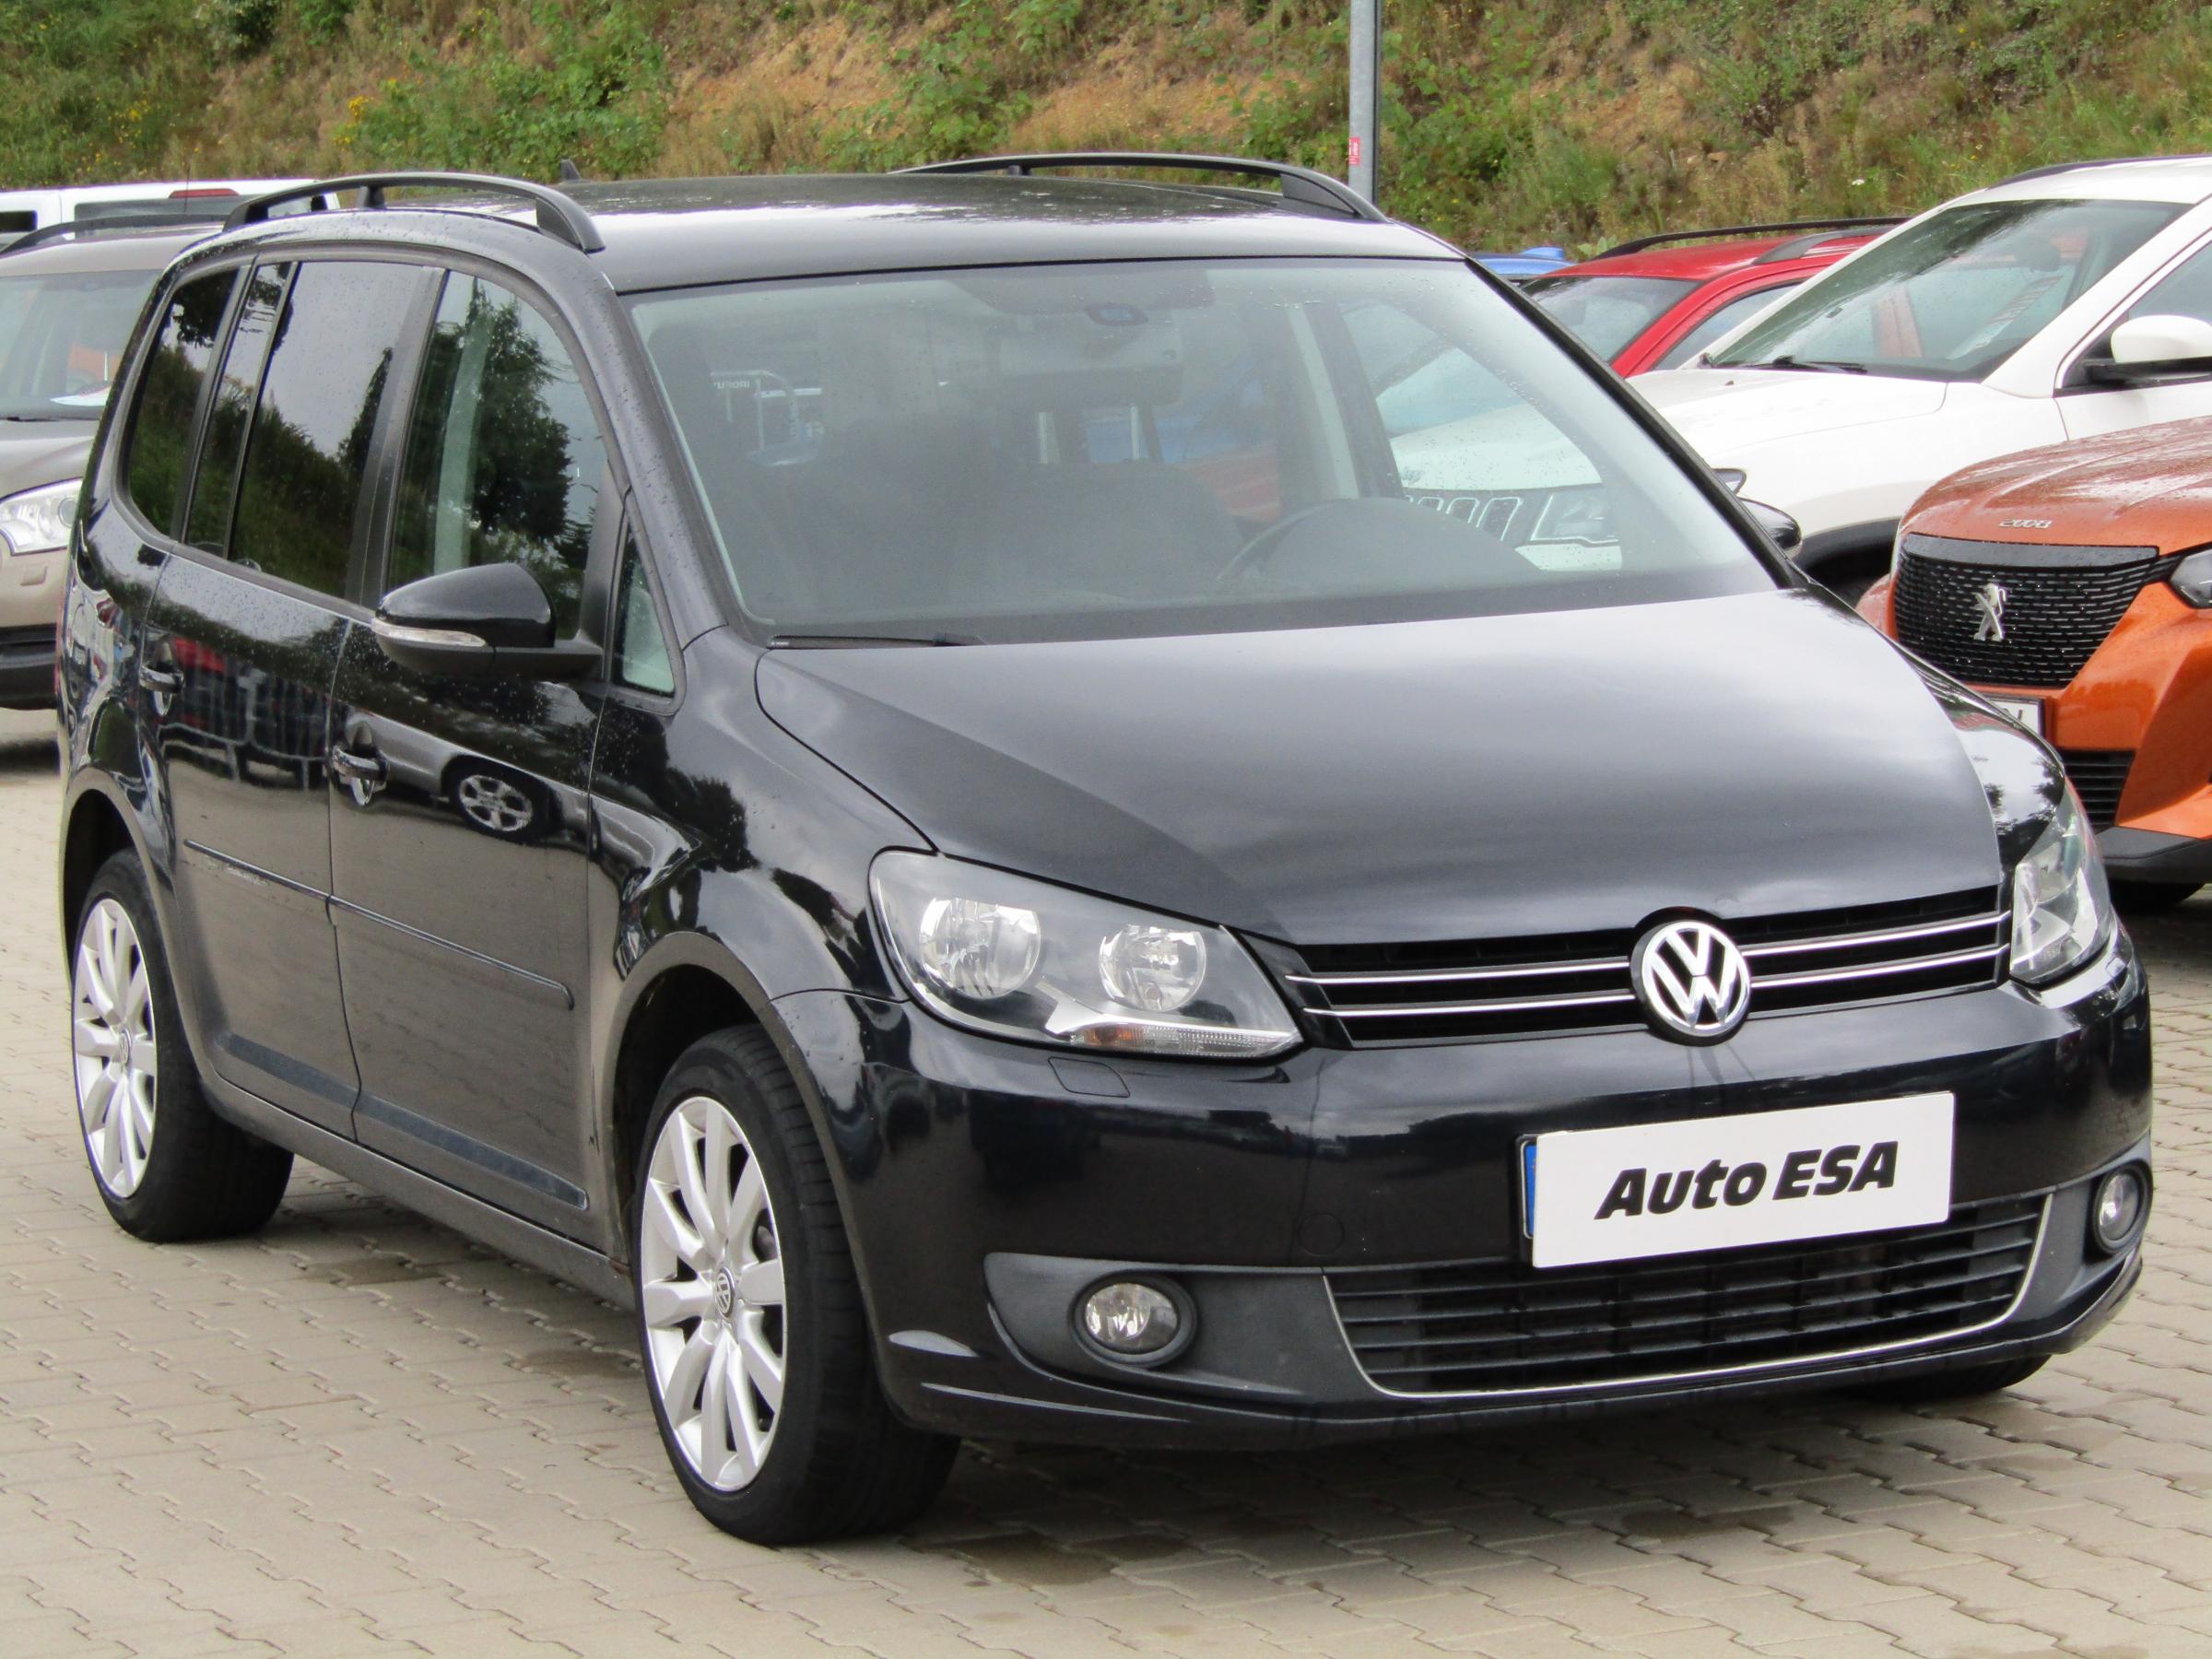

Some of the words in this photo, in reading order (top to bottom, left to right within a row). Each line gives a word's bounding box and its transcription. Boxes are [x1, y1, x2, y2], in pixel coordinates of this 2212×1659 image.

[1998, 518, 2052, 529] 2008
[1641, 921, 1751, 1037] VW
[1594, 1159, 1768, 1219] Auto
[1772, 1140, 1899, 1201] ESA
